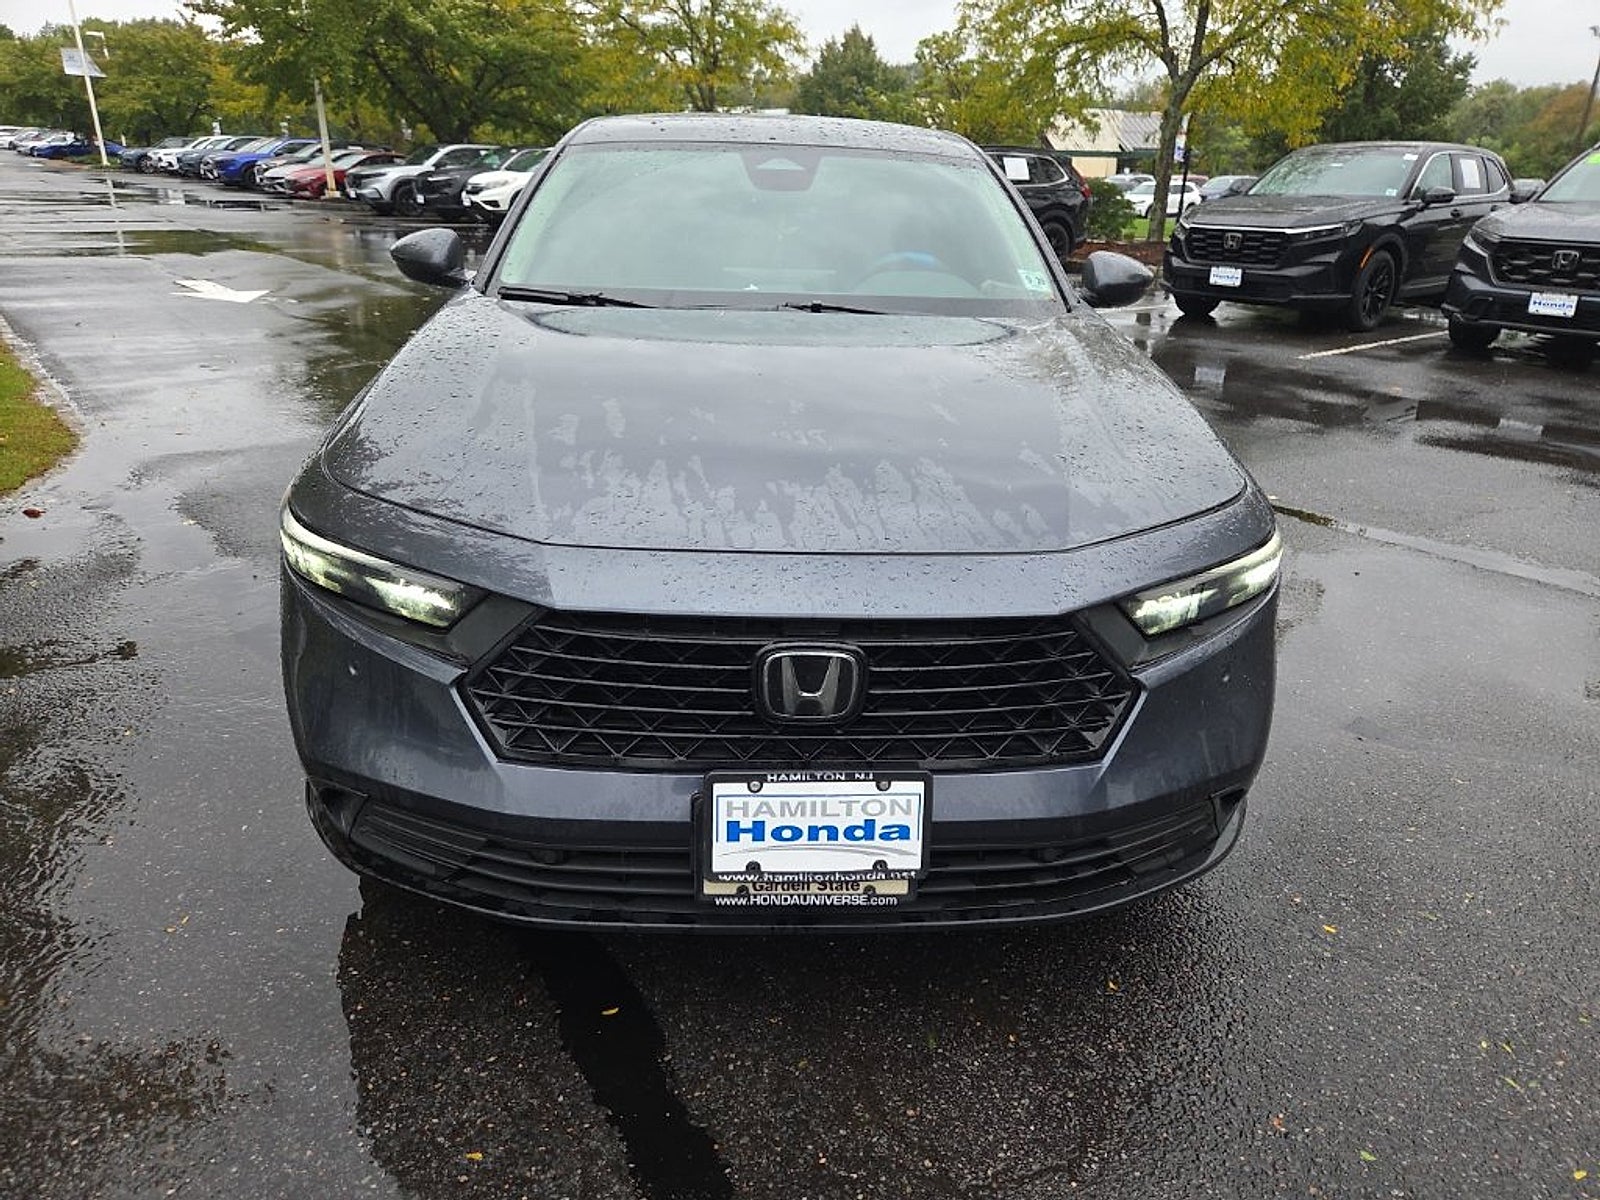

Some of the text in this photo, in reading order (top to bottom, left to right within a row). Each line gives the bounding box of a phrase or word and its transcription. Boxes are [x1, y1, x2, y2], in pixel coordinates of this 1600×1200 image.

[766, 771, 846, 782] HAMILTON
[726, 798, 912, 818] HAMILTON
[726, 818, 911, 843] Honda
[751, 881, 861, 892] Garden State
[714, 894, 899, 906] www.HONDAUNIVERSE.com
